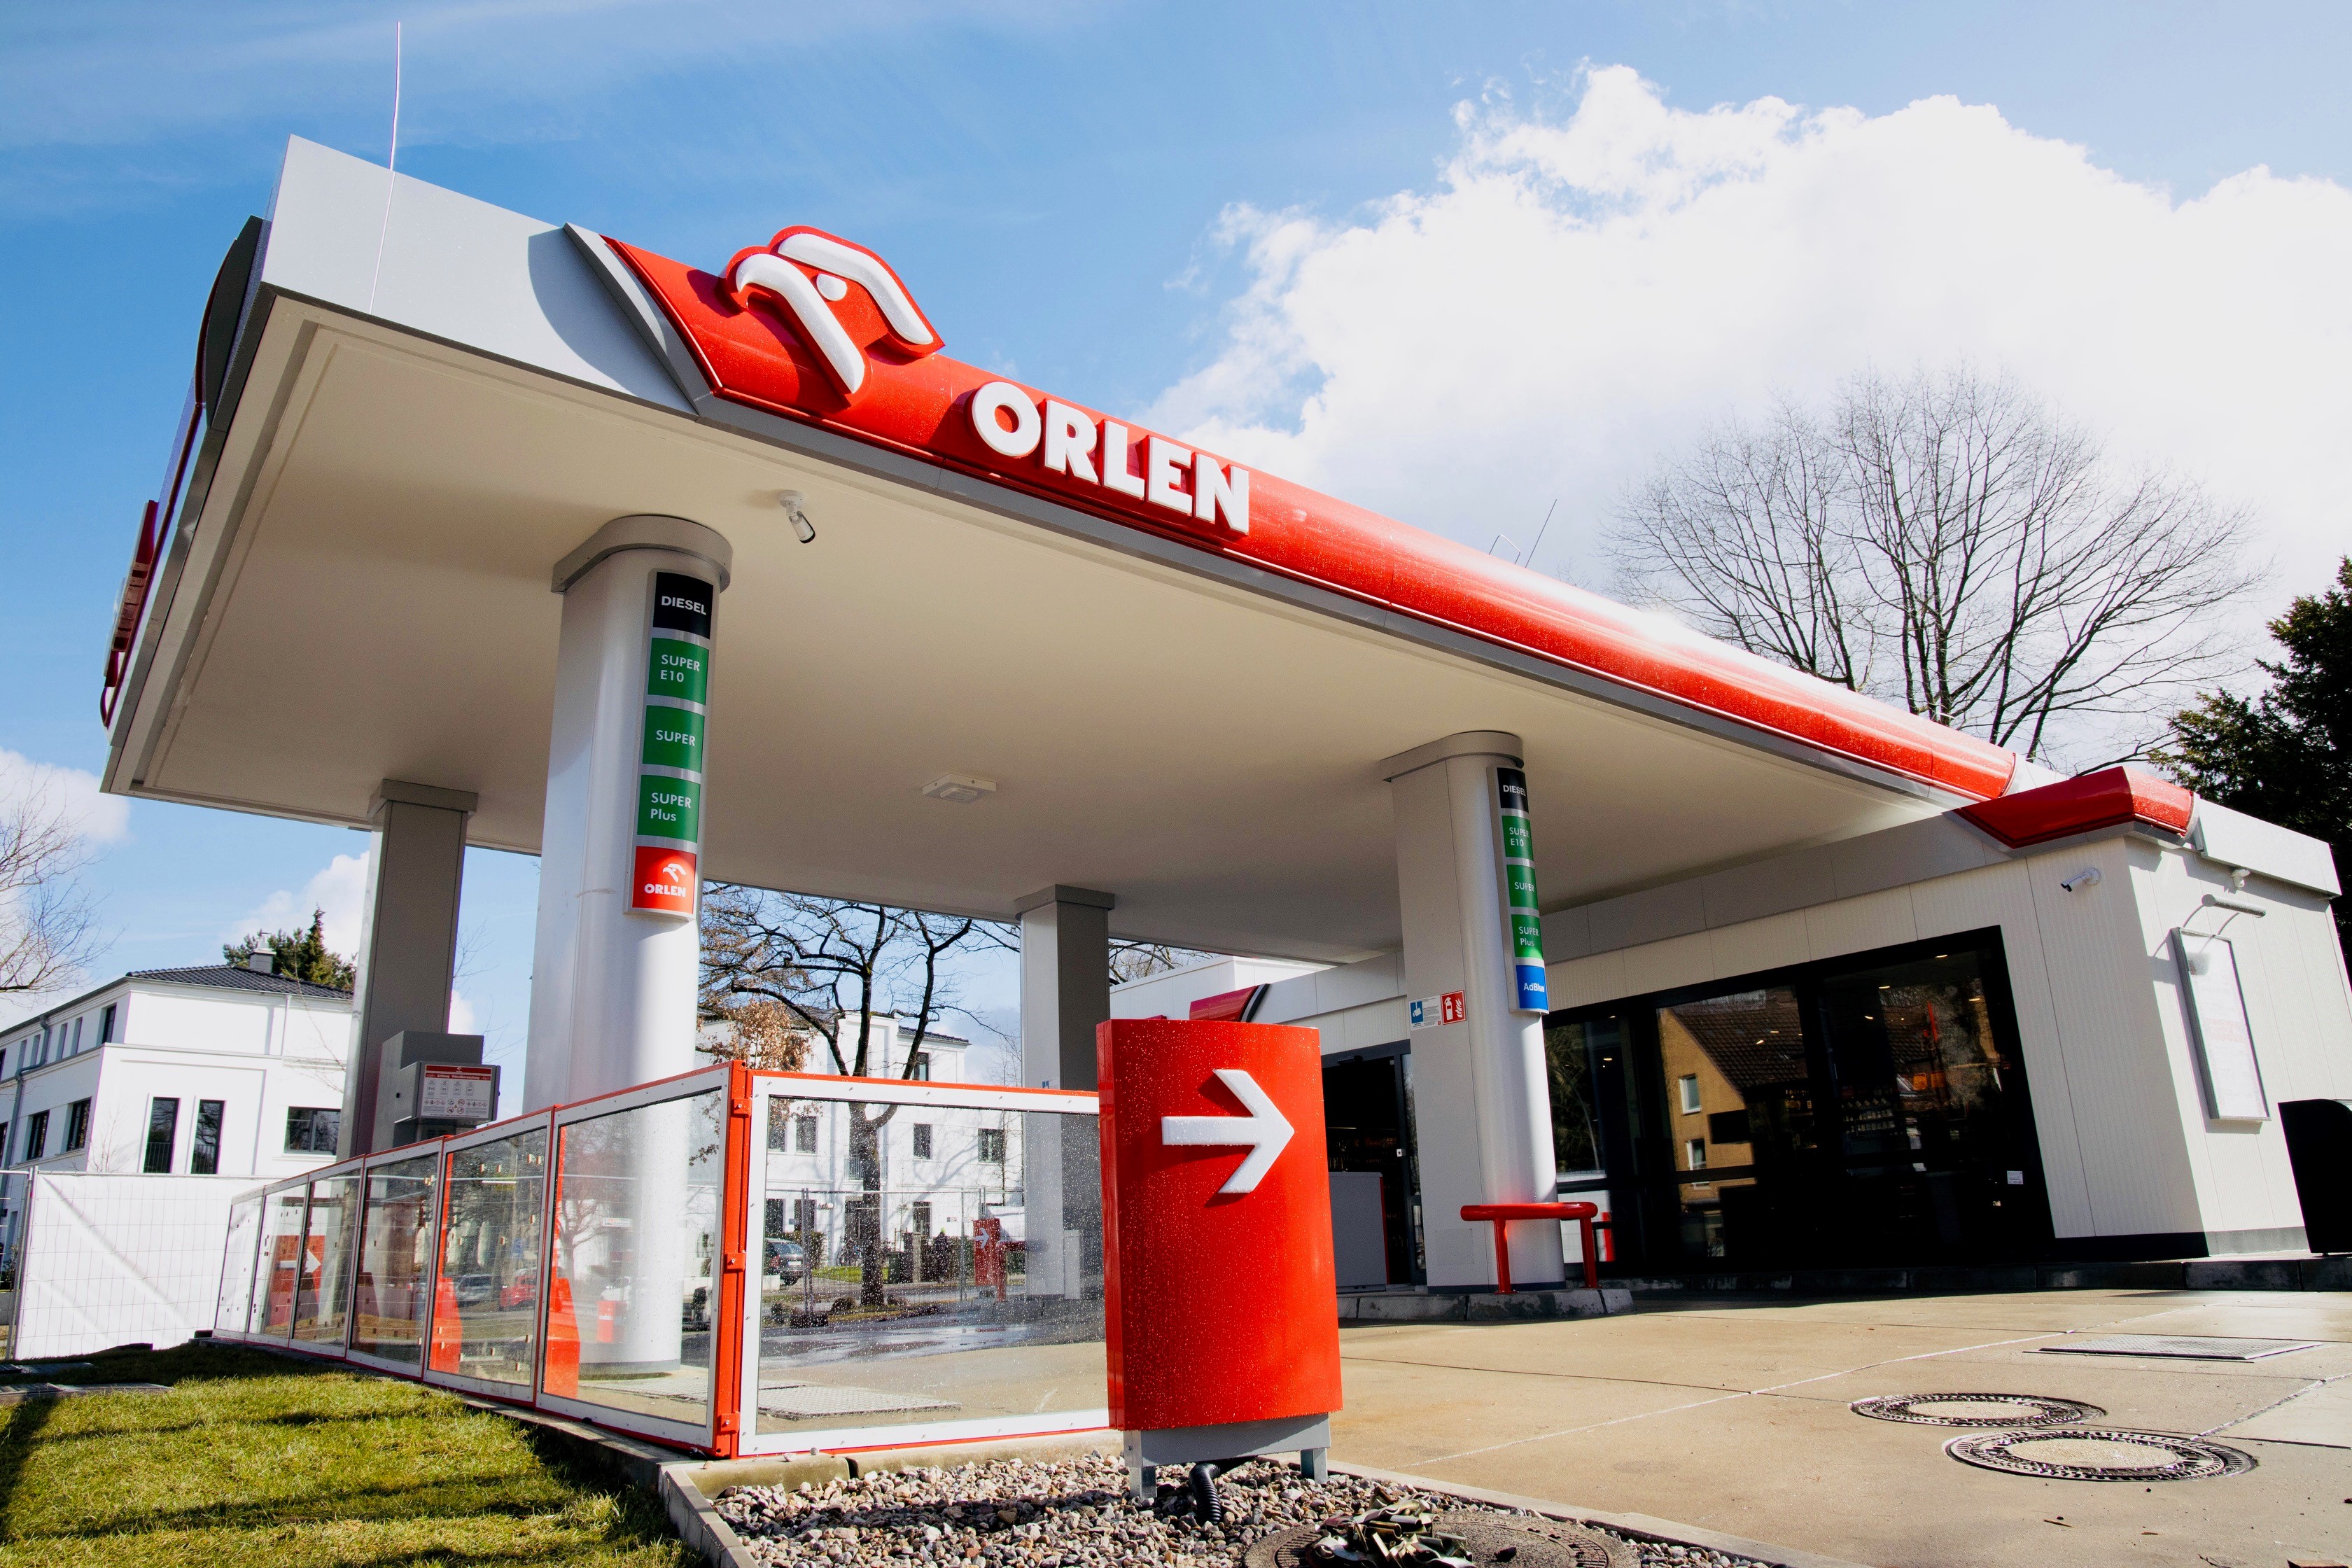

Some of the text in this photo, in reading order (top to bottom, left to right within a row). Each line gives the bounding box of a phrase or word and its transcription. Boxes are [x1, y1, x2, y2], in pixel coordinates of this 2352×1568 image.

[972, 382, 1250, 535] ORLEN
[662, 596, 706, 615] DIESEL
[661, 654, 700, 672] SUPER
[660, 670, 684, 682] E10
[656, 729, 696, 746] SUPER
[1503, 785, 1526, 797] DIESEL
[651, 792, 692, 808] SUPER
[650, 808, 677, 821] Plus
[1509, 827, 1529, 837] SUPER
[644, 883, 686, 897] ORLEN
[1514, 882, 1534, 892] SUPER
[1518, 926, 1539, 937] SUPER
[1520, 937, 1534, 946] Plus
[1523, 982, 1545, 993] AdBlue
